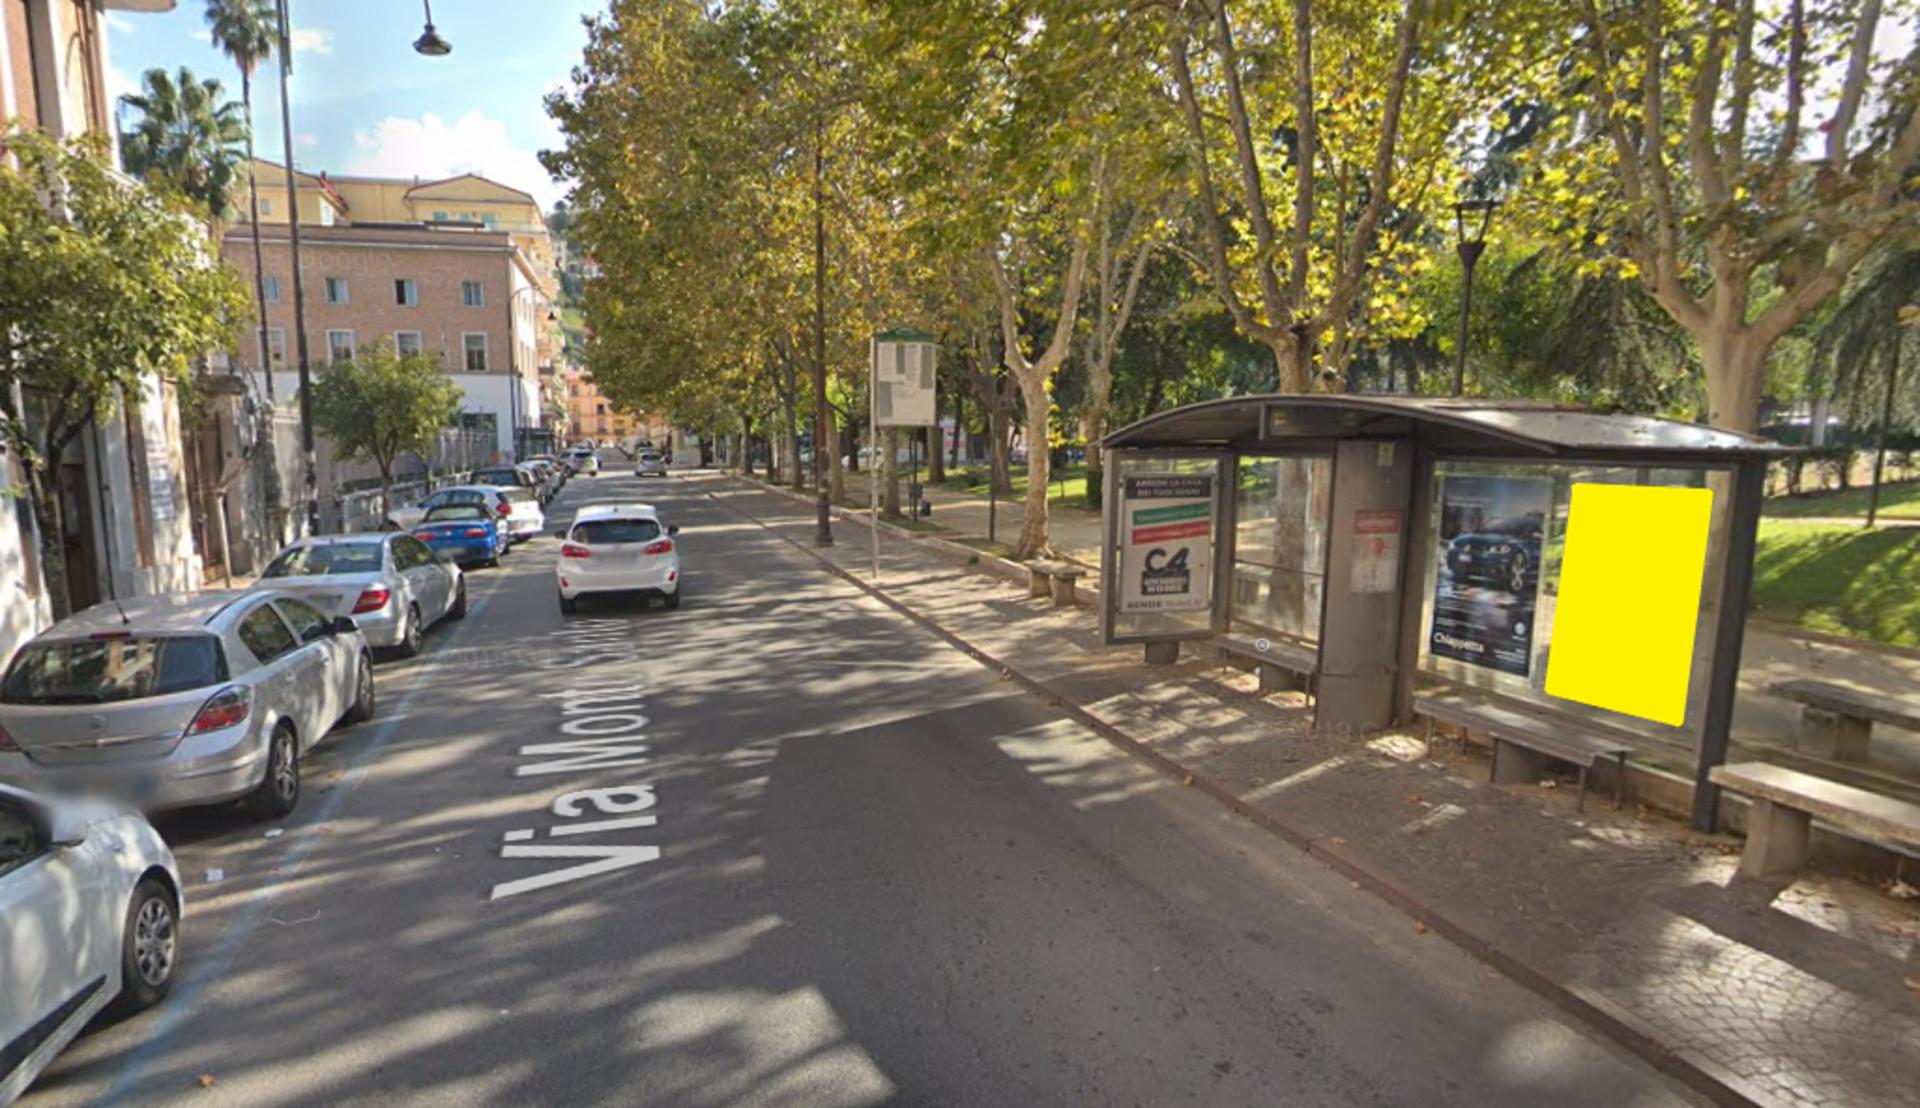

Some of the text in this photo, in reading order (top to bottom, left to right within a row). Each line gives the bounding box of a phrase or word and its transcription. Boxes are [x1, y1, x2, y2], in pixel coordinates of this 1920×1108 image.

[1182, 479, 1202, 487] CASA
[1137, 488, 1152, 497] DEI
[1174, 487, 1201, 496] SOGNI
[1145, 546, 1190, 574] C4
[1433, 632, 1485, 653] Chiappetta
